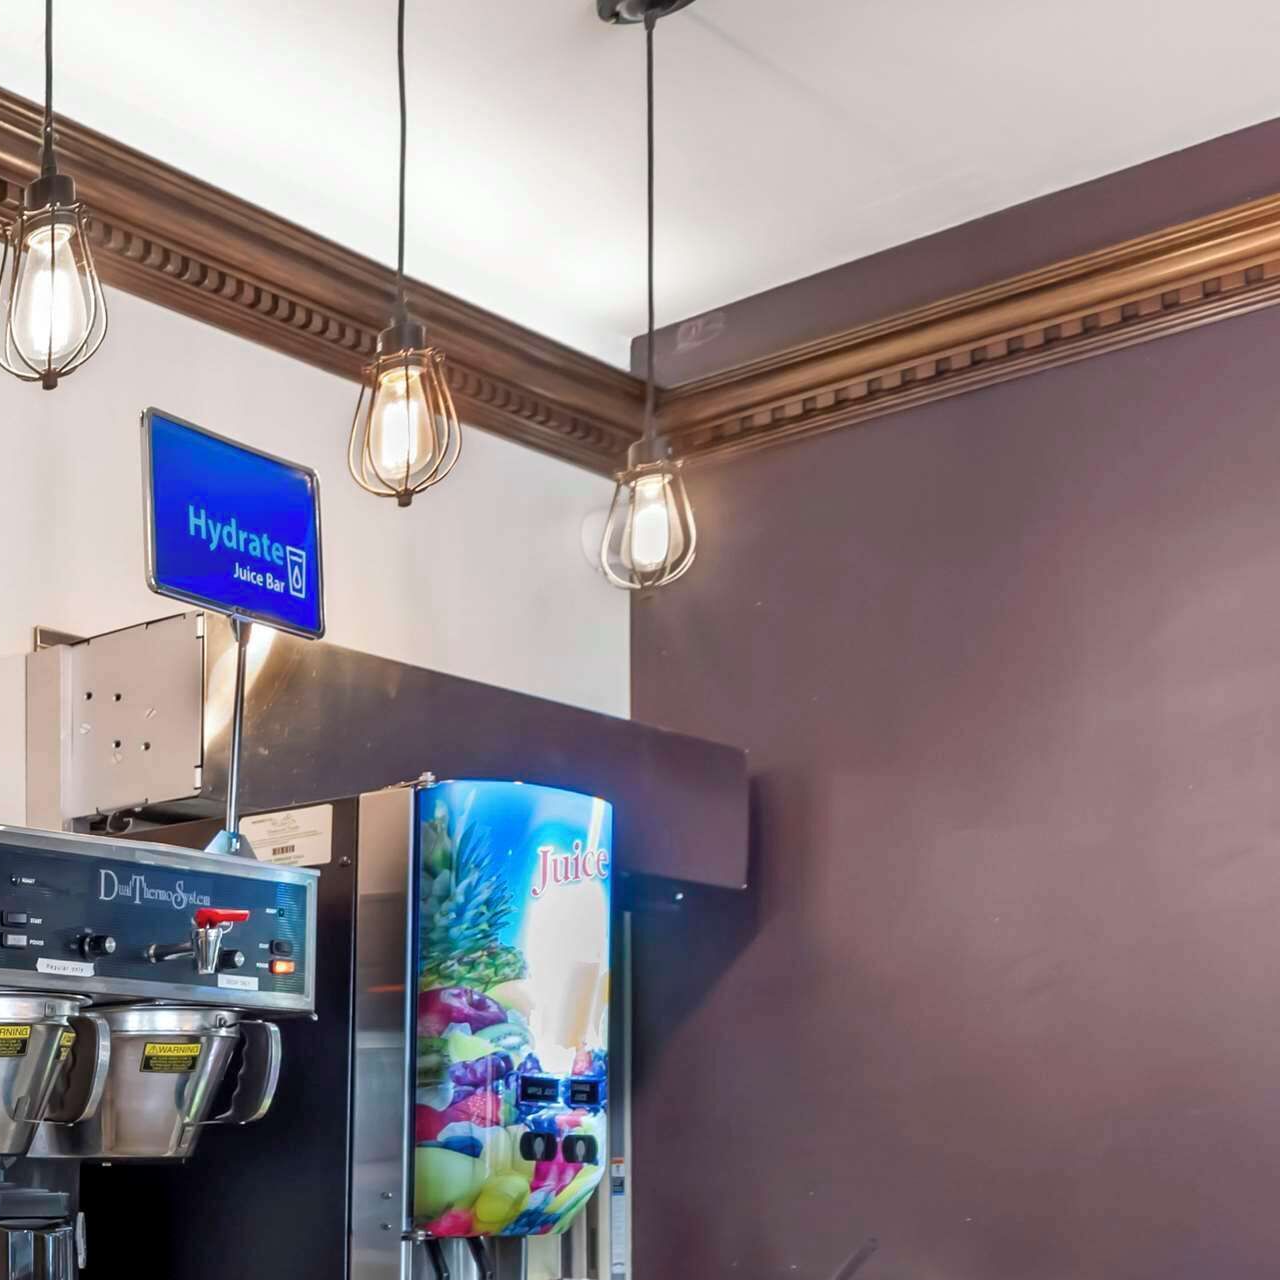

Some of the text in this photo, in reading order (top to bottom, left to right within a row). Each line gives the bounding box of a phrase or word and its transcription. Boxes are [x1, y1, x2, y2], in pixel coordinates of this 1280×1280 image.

[189, 505, 284, 565] Hydrate
[233, 562, 285, 593] Juice Bar
[531, 842, 609, 896] Juice
[159, 1045, 199, 1054] WARNING
